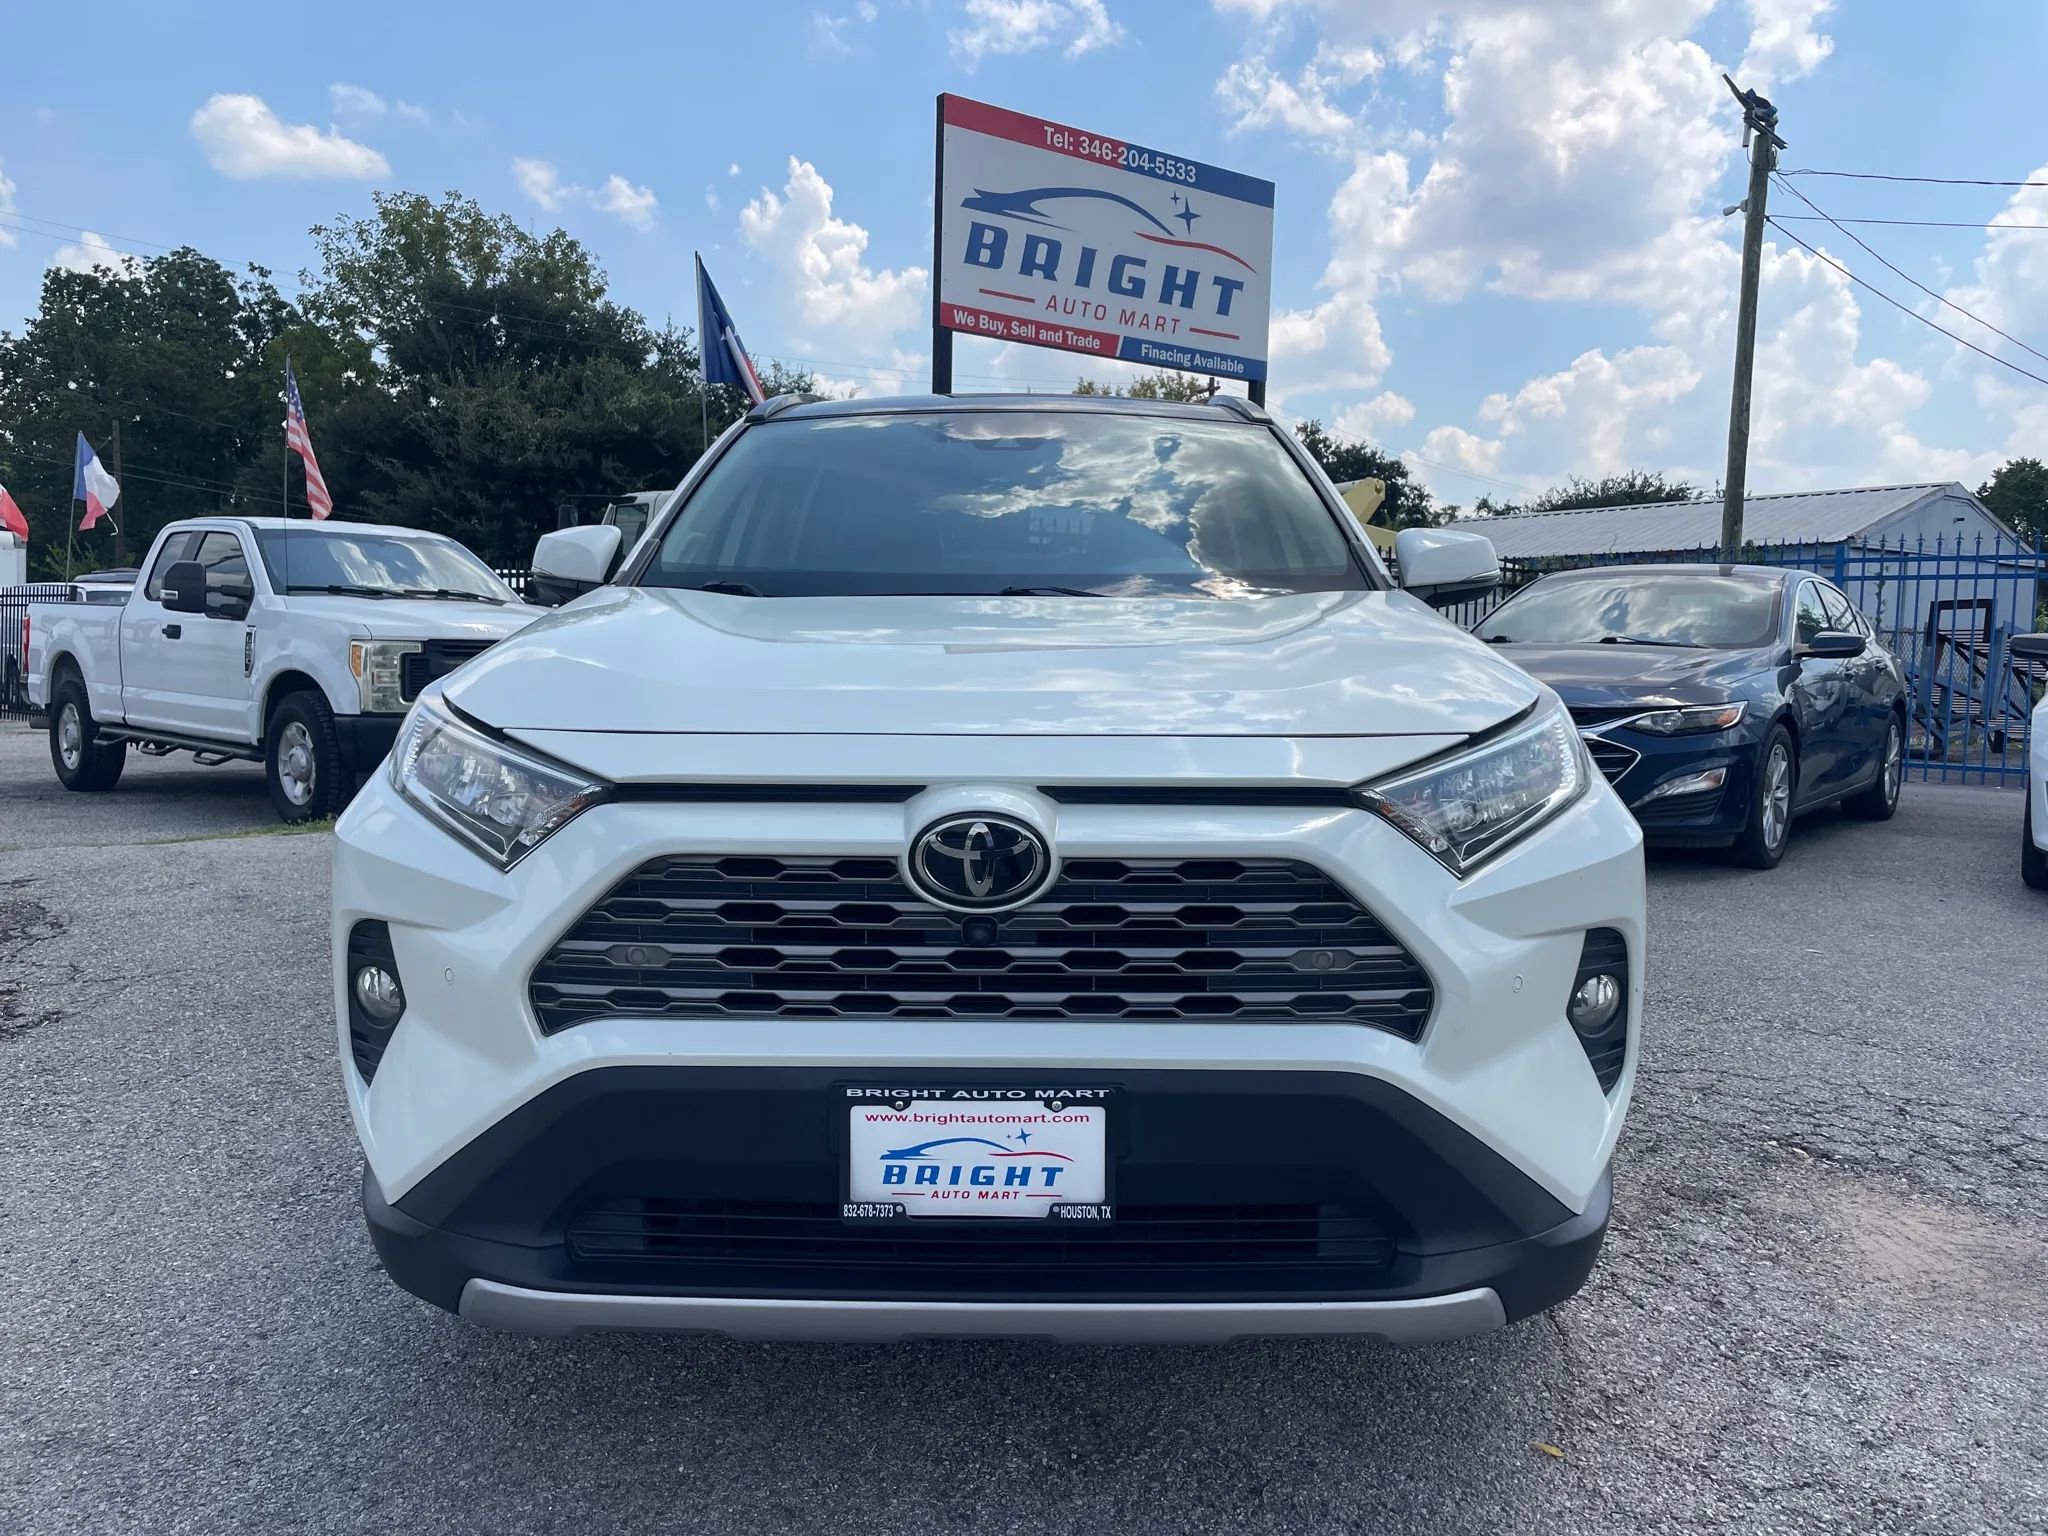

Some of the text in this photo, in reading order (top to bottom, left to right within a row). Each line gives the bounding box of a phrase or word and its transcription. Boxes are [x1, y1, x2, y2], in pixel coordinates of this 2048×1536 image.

[1043, 126, 1197, 183] Tel: 346-204-5533
[963, 221, 1244, 317] BRIGHT
[1045, 294, 1181, 334] AUTO MART
[953, 309, 1101, 350] We Buy, Sell and Trade
[1141, 343, 1244, 374] Finacing Available
[846, 1088, 1110, 1099] BRIGHT AUTO MART
[865, 1112, 1090, 1125] www.brightautomart.com
[882, 1164, 1064, 1187] BRIGHT
[930, 1190, 1020, 1200] AUTO MART
[843, 1204, 894, 1218] 832-678-7373
[1060, 1205, 1111, 1220] HOUSTON, TX
